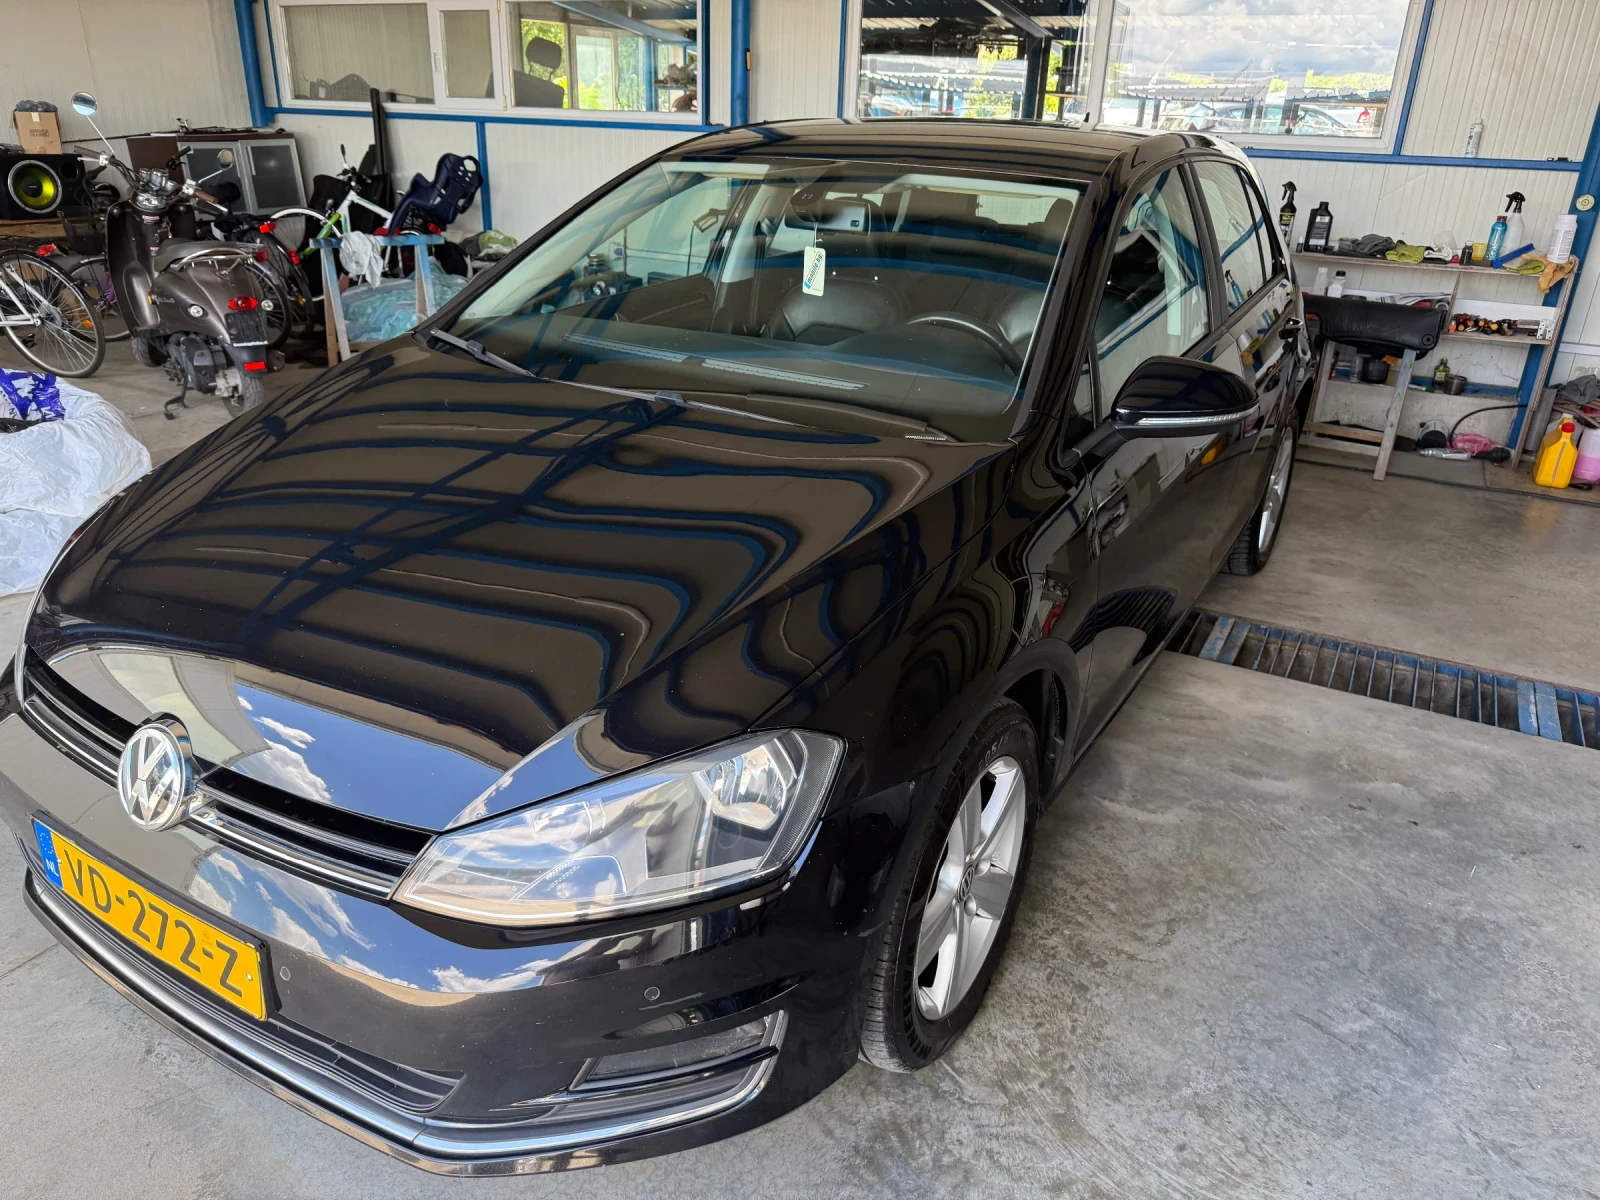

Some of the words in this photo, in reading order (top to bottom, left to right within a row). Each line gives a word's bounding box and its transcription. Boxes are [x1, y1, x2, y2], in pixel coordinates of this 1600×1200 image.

[807, 254, 823, 284] mobilebg
[45, 858, 60, 877] NL
[63, 848, 243, 998] VD-272-Z
